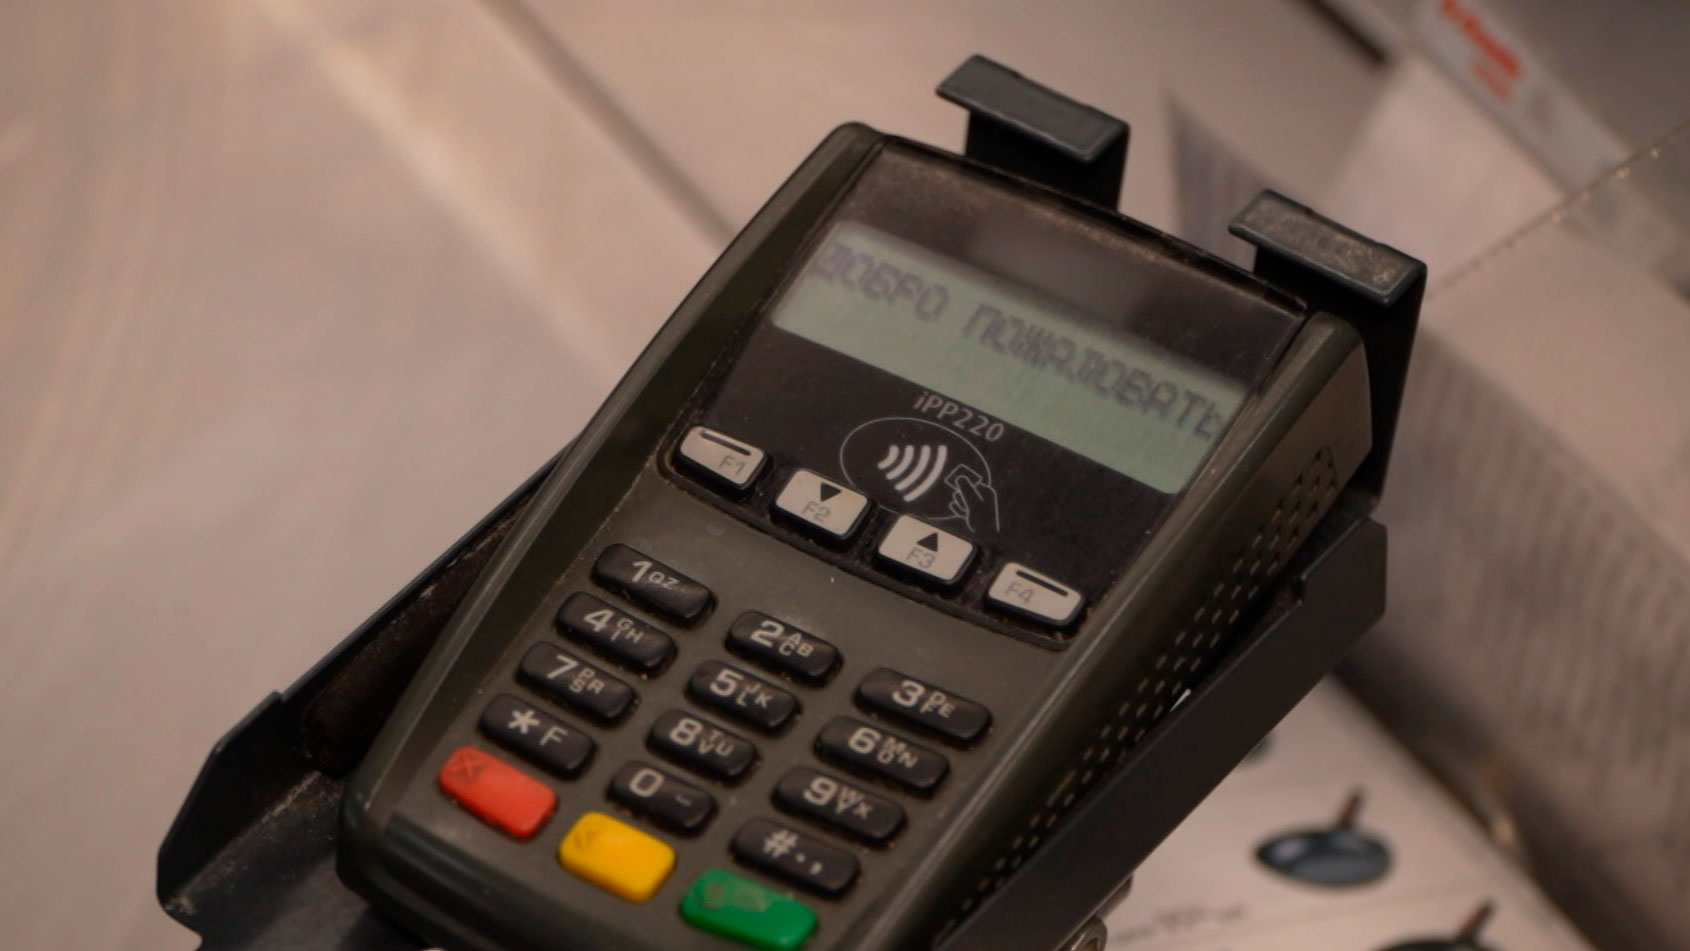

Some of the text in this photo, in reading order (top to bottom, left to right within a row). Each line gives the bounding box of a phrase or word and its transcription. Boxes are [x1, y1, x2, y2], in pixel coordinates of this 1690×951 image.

[912, 390, 1005, 444] iPP220
[718, 455, 745, 478] F1
[802, 501, 831, 523] F2
[905, 548, 936, 570] F3
[1004, 581, 1035, 604] F4
